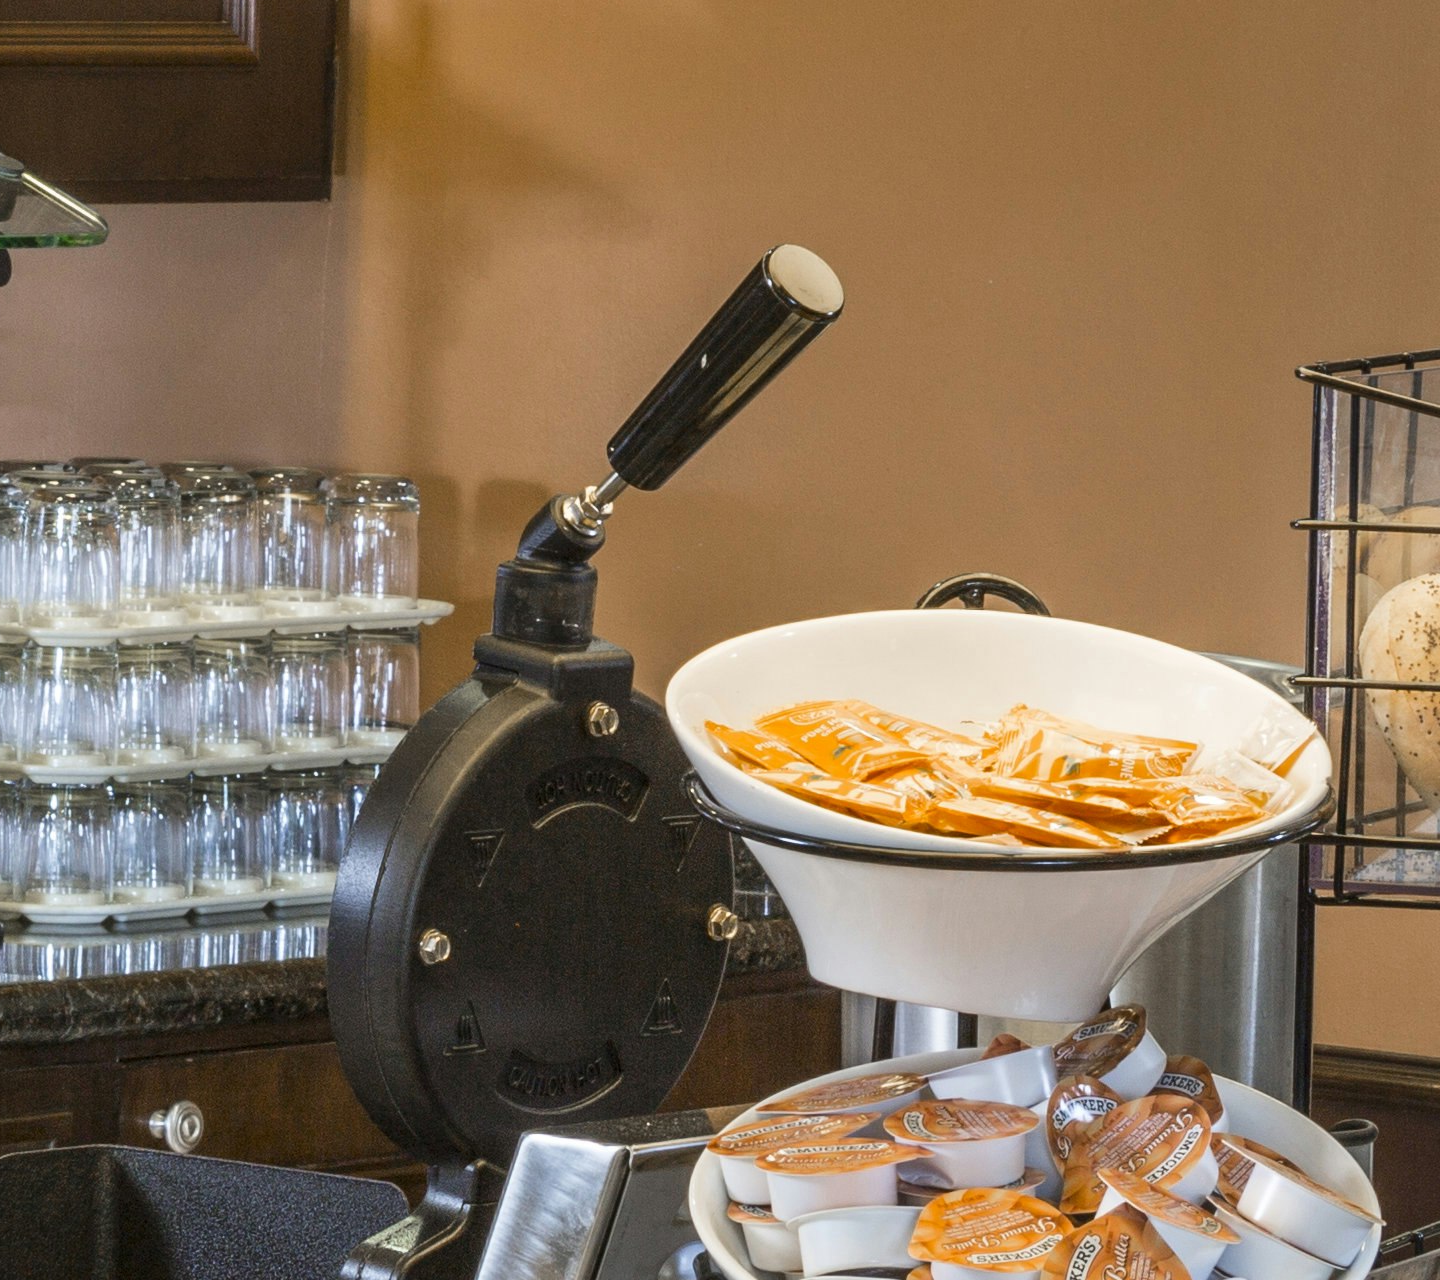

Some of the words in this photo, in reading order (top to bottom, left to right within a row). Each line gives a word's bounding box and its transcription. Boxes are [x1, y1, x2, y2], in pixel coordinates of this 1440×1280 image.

[1146, 1129, 1200, 1183] SMUCKE
[999, 1216, 1057, 1242] Peanut
[943, 1236, 1001, 1250] Butter
[976, 1235, 1060, 1264] SMUCKER'S
